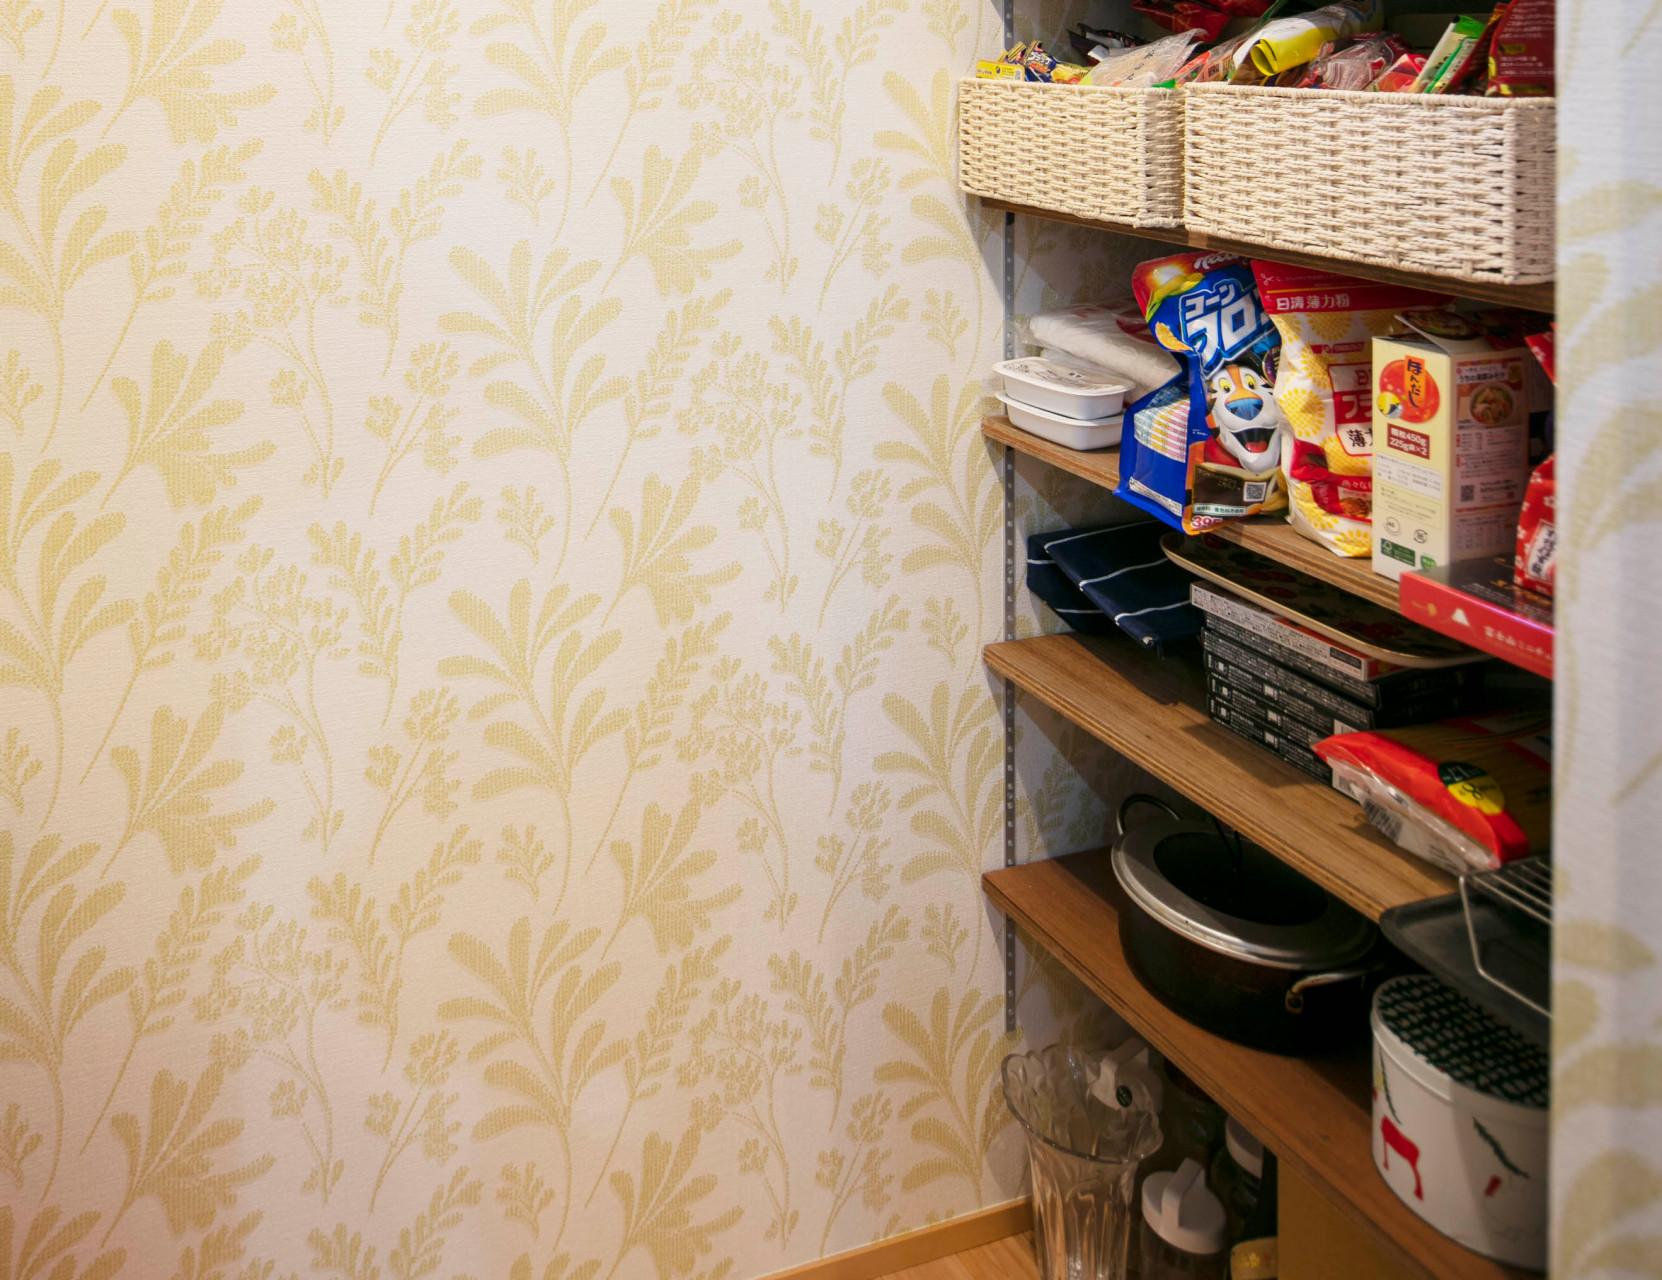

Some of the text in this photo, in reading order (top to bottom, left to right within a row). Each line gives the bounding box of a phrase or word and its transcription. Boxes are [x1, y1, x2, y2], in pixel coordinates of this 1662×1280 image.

[1185, 283, 1235, 321] コーン
[1407, 358, 1422, 408] ほんだし
